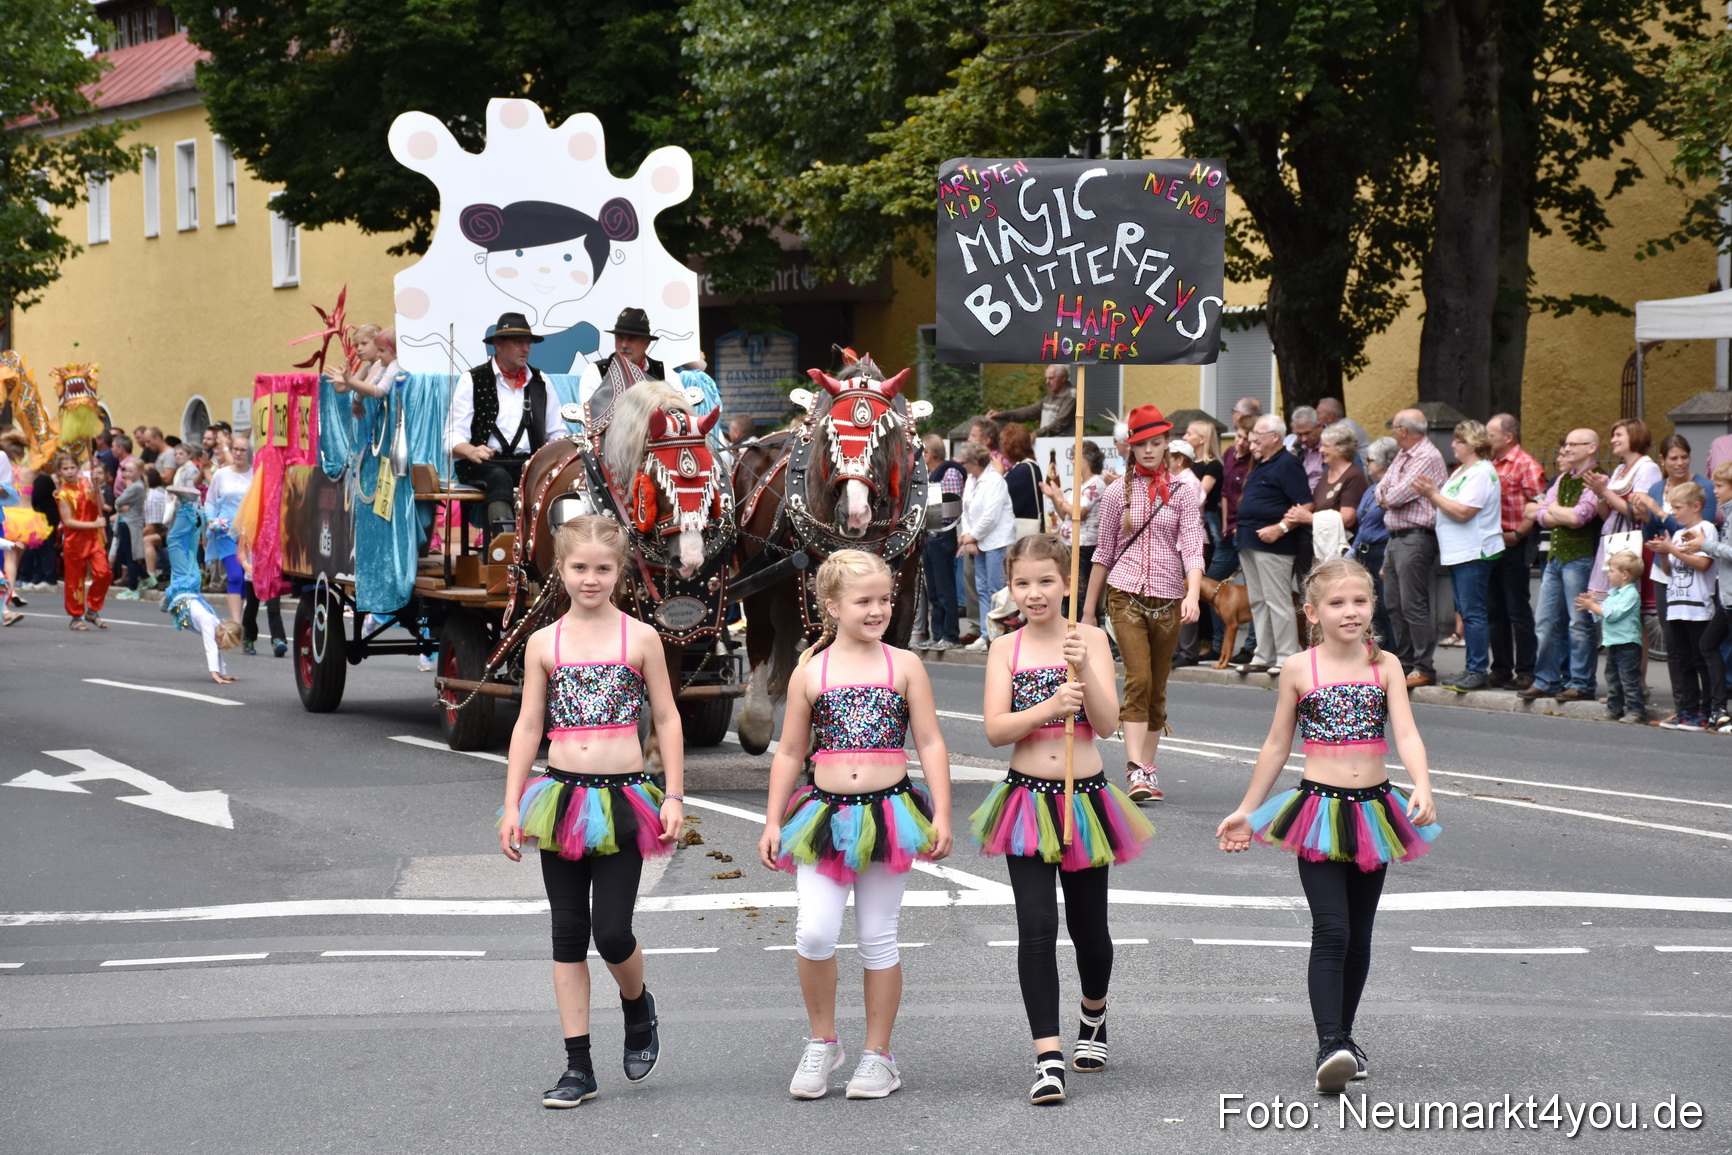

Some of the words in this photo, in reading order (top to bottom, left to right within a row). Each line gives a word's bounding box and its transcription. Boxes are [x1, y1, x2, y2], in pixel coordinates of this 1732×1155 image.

[938, 160, 1029, 200] ARTISTEN
[1189, 162, 1223, 188] NO
[944, 194, 998, 220] KIDS
[1143, 172, 1224, 224] NEMOS
[956, 167, 1109, 275] MAGIC
[963, 221, 1224, 341] BUTTERFLYS
[1056, 293, 1156, 342] HAPPY
[1040, 331, 1139, 362] HOPPERS
